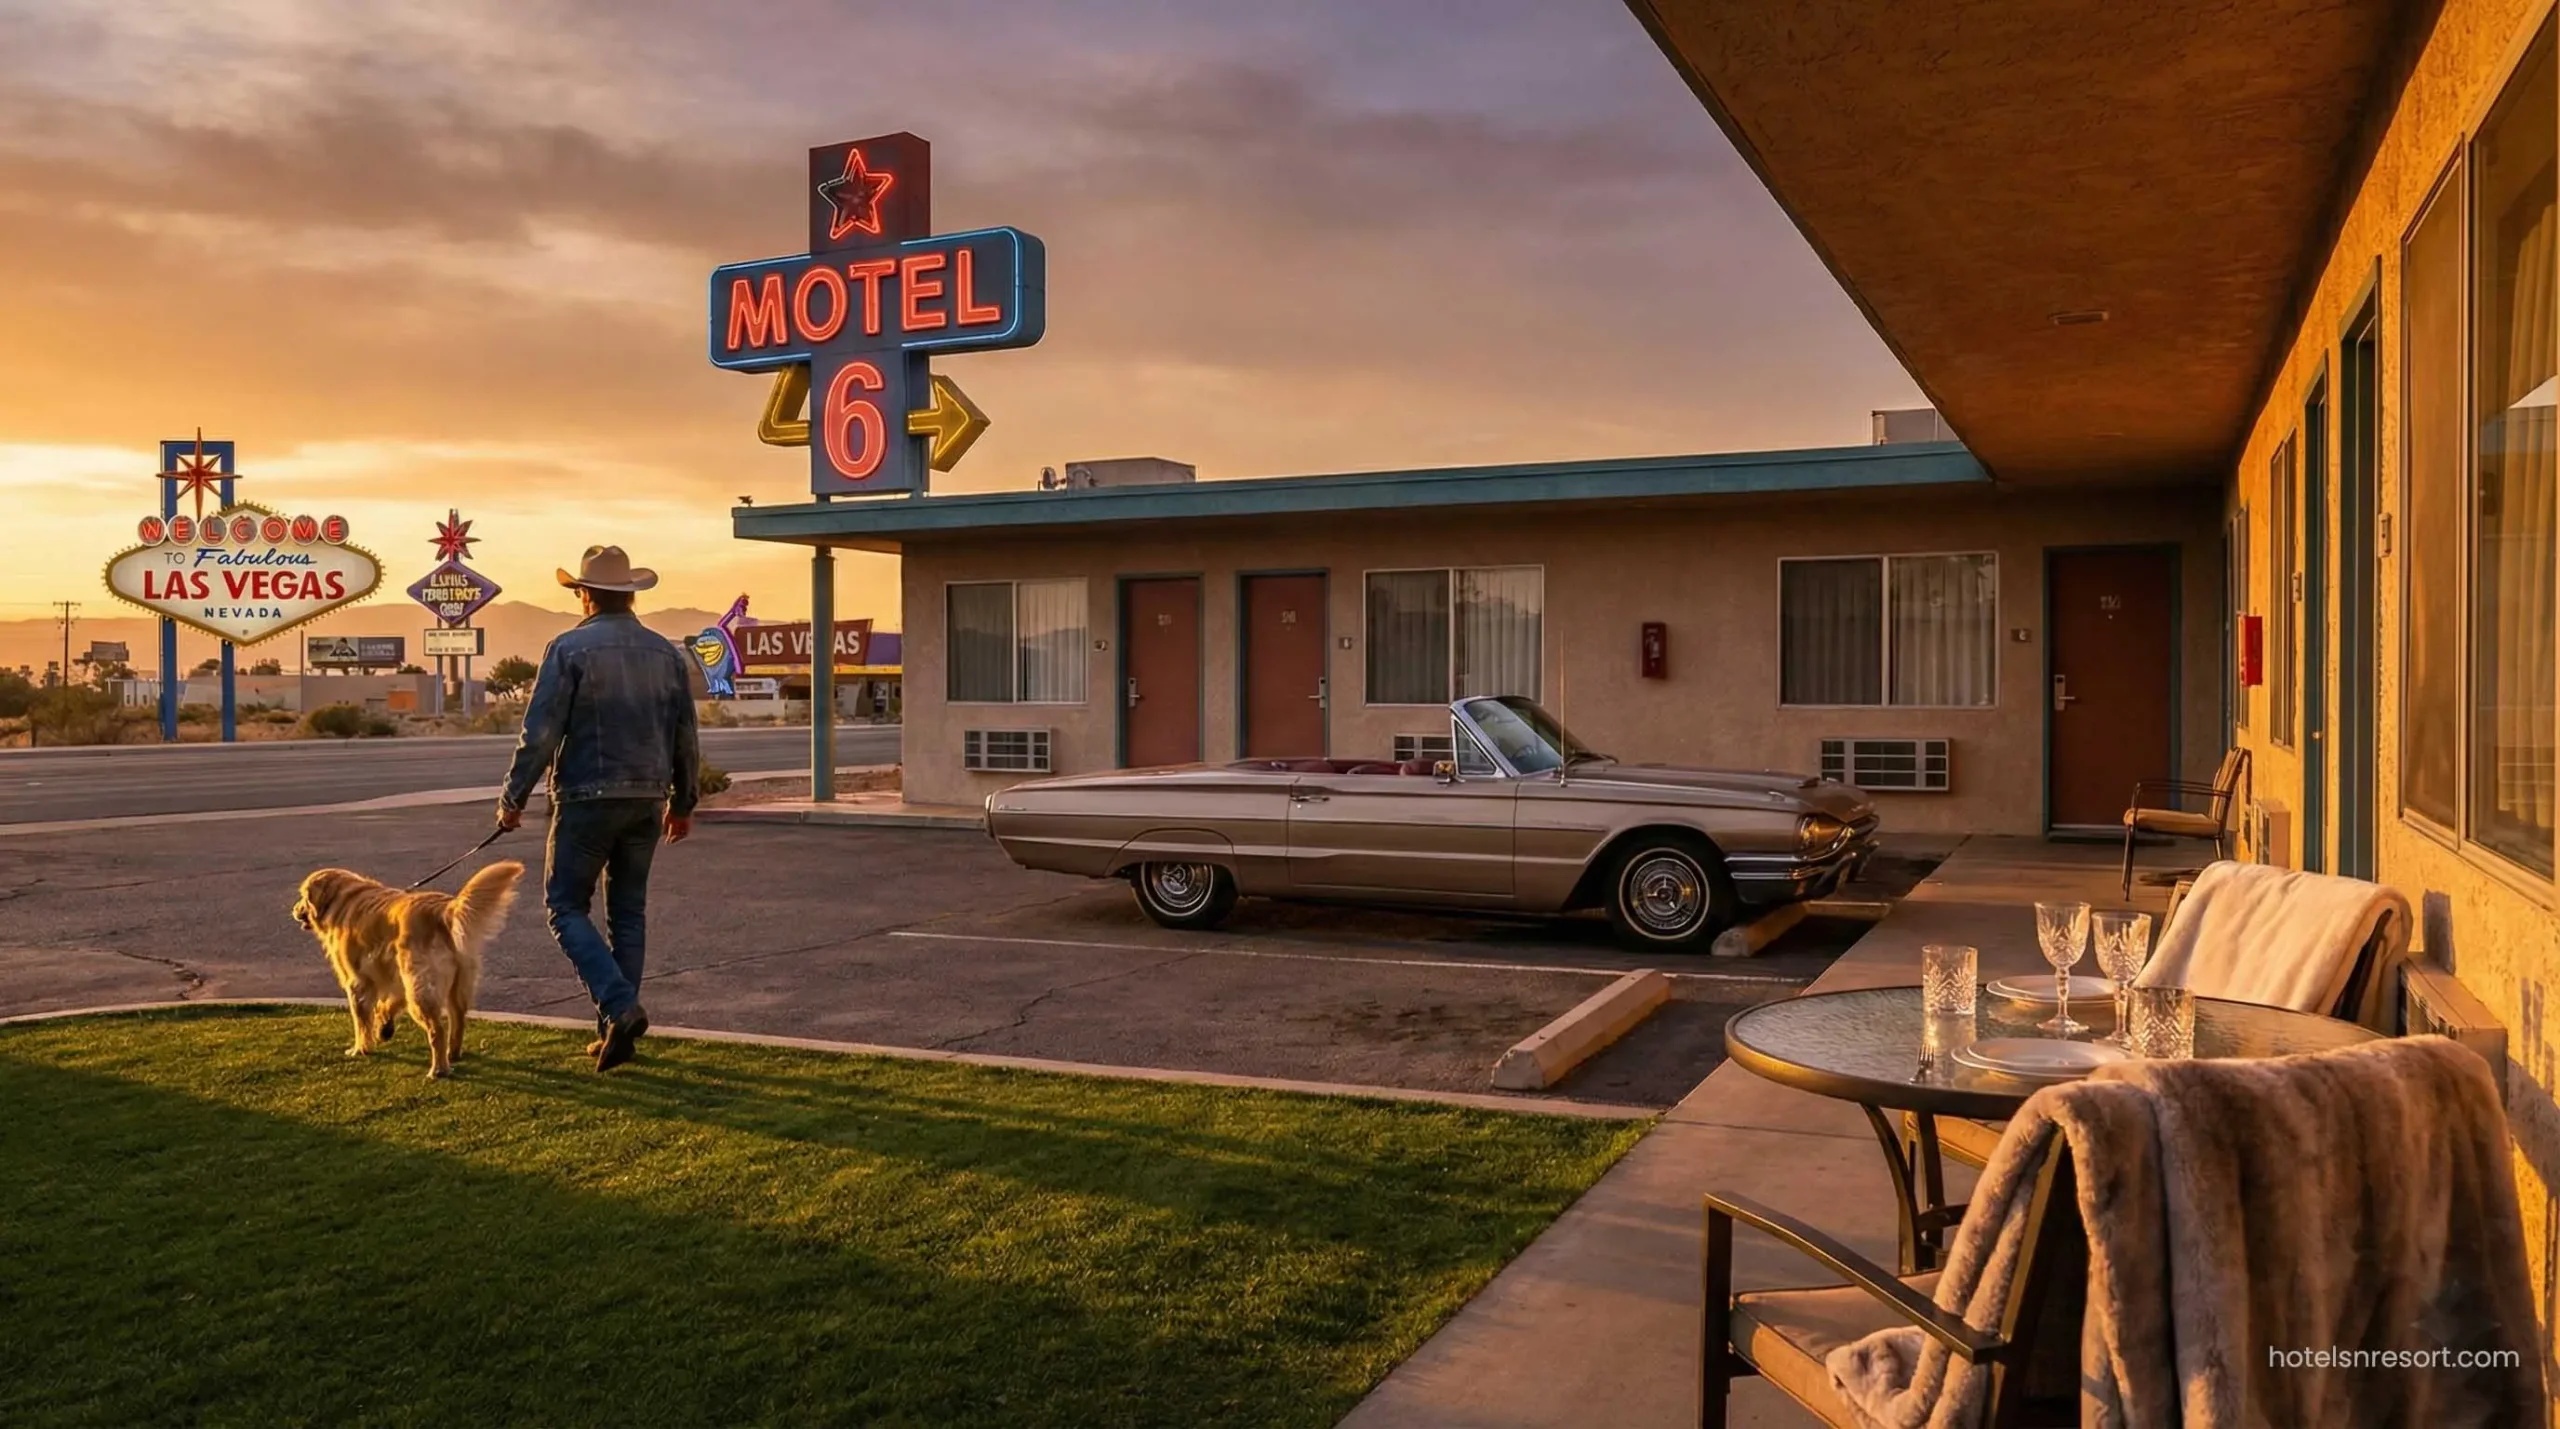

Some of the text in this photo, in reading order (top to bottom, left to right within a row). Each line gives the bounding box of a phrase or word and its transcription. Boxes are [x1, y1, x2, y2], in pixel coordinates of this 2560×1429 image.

[727, 249, 1001, 349] MOTEL
[824, 361, 887, 479] 6
[142, 519, 342, 544] WELCOME
[164, 548, 317, 567] TO Fabulous
[144, 570, 346, 600] LAS VEGAS
[204, 607, 282, 618] NEVADA
[746, 631, 860, 655] LAS VEAS
